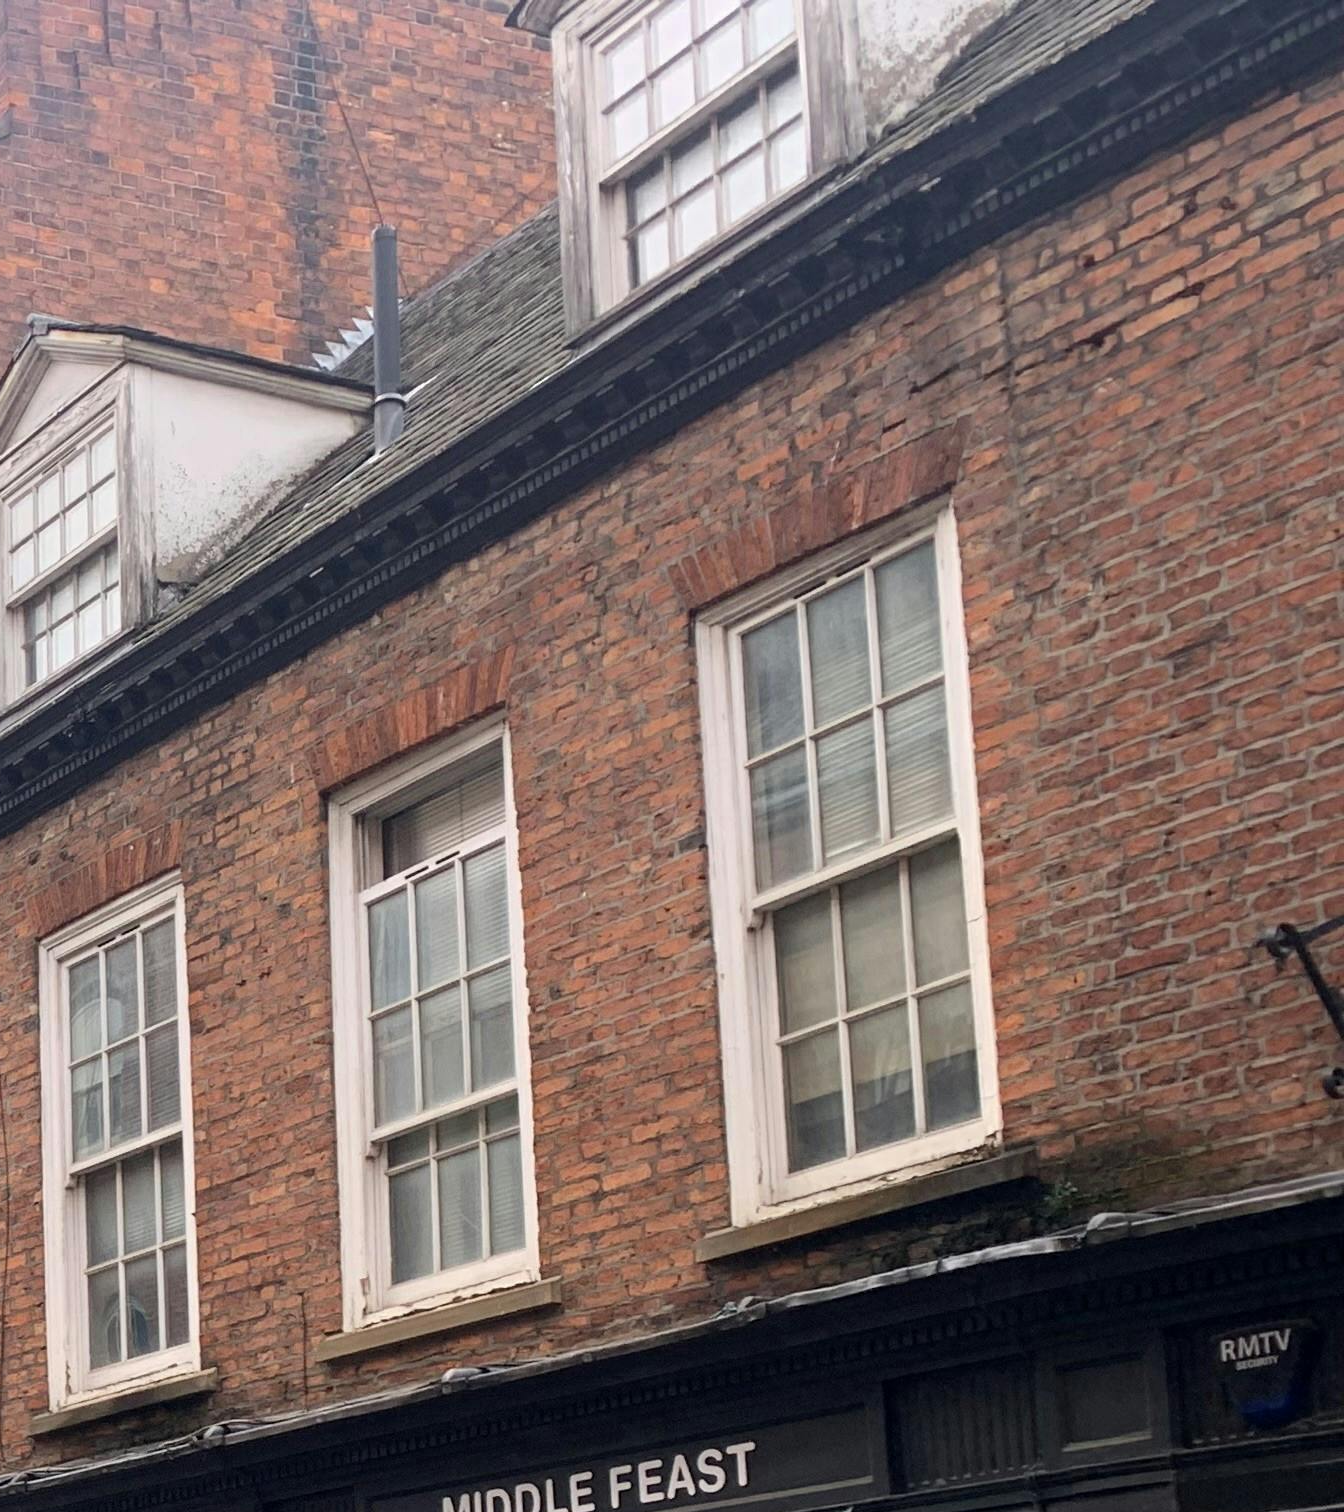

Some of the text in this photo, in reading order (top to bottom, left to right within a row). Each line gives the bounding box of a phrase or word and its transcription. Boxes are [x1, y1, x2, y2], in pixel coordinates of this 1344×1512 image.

[1219, 1327, 1292, 1363] RMTV
[1235, 1355, 1280, 1371] SECURITY
[609, 1441, 756, 1509] FEAST
